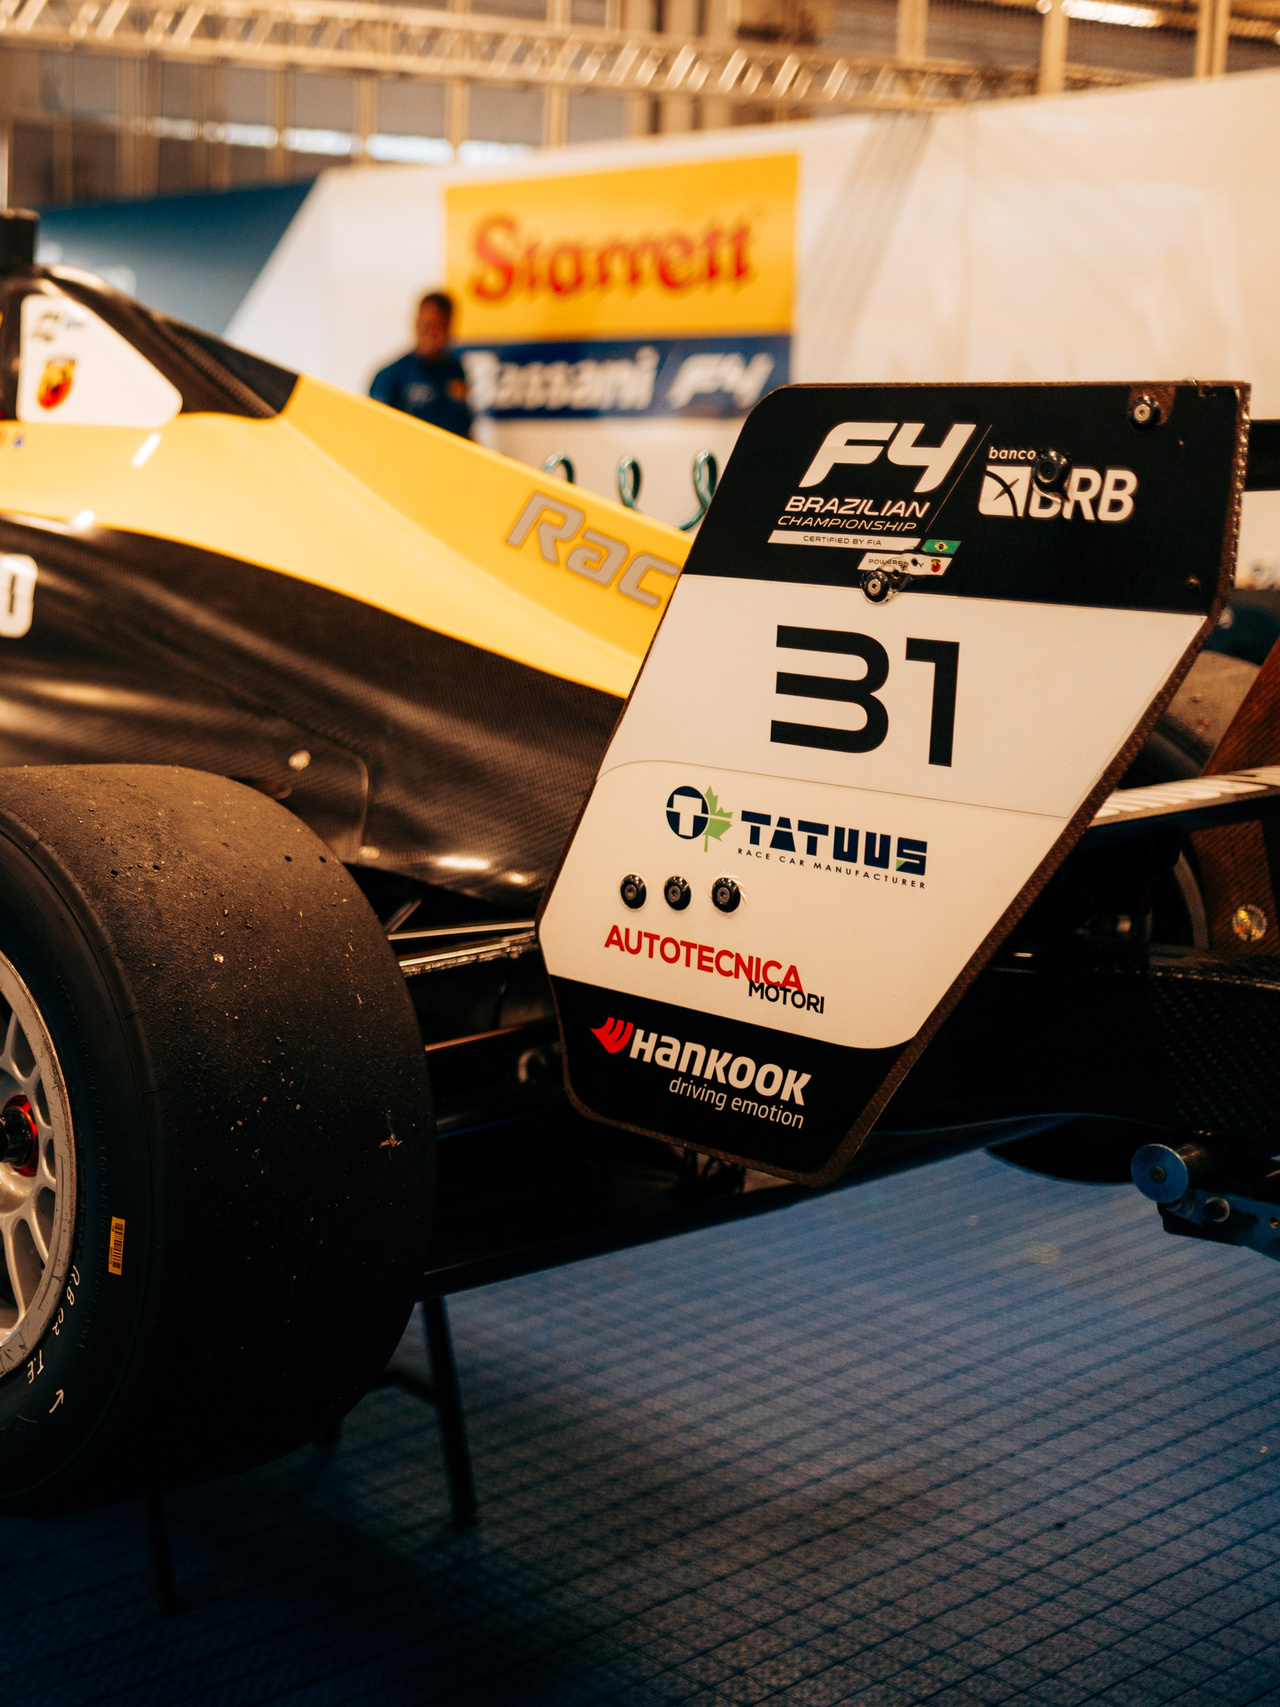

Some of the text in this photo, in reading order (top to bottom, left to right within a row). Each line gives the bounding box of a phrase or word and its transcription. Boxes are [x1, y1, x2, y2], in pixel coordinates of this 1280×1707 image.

[798, 421, 977, 494] F4
[988, 446, 1037, 460] banco
[777, 515, 918, 532] CHAMPIONSHIP
[784, 495, 931, 518] BRAZILIAN
[505, 490, 682, 609] Rac
[803, 535, 882, 546] CERTIFIED BY FIA
[770, 625, 960, 767] 31
[741, 810, 928, 876] TATUUS
[738, 848, 926, 890] RACE CAR MANUFACTURER
[604, 924, 804, 992] AUTOTECNICA
[749, 979, 825, 1015] MOTORI
[668, 1077, 805, 1129] driving emotion
